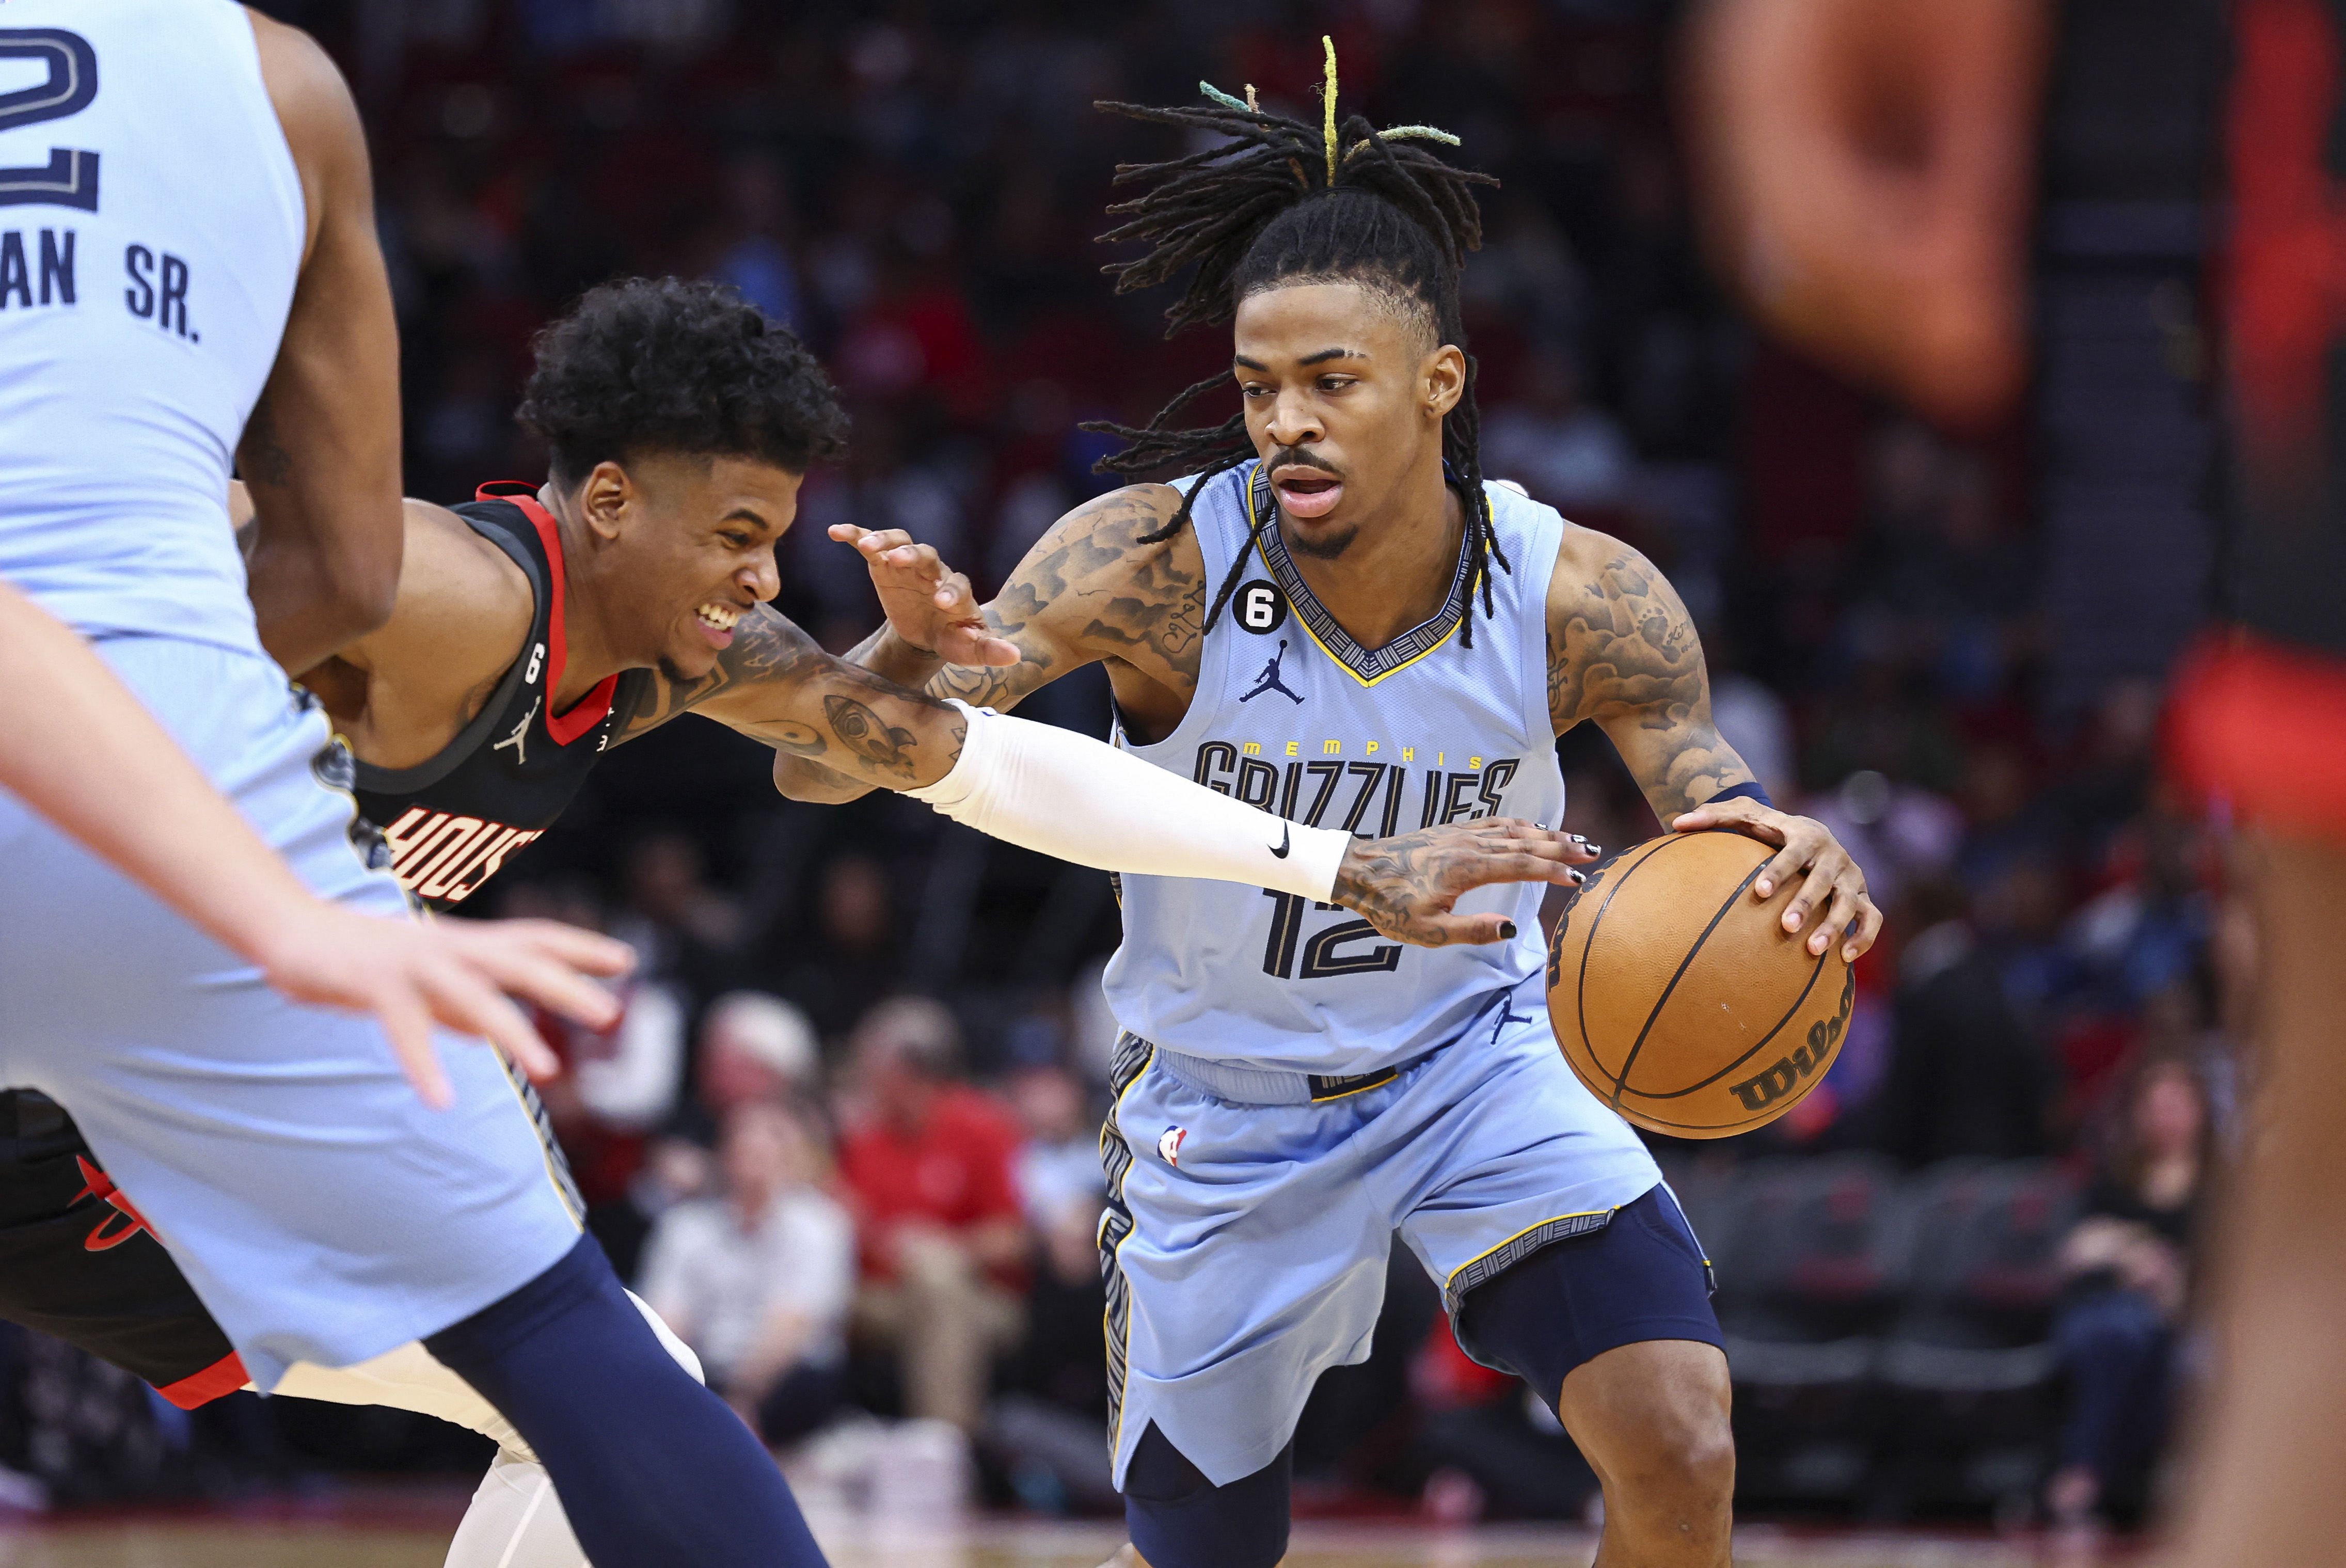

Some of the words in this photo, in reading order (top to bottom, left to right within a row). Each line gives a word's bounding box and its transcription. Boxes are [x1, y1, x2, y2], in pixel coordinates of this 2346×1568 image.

[0, 28, 100, 214] 2
[125, 242, 201, 343] SR.
[1245, 588, 1274, 627] 6
[525, 642, 545, 685] 6
[1242, 739, 1482, 770] MEMPHIS
[384, 805, 546, 903] HOUS
[1263, 887, 1403, 979] 12
